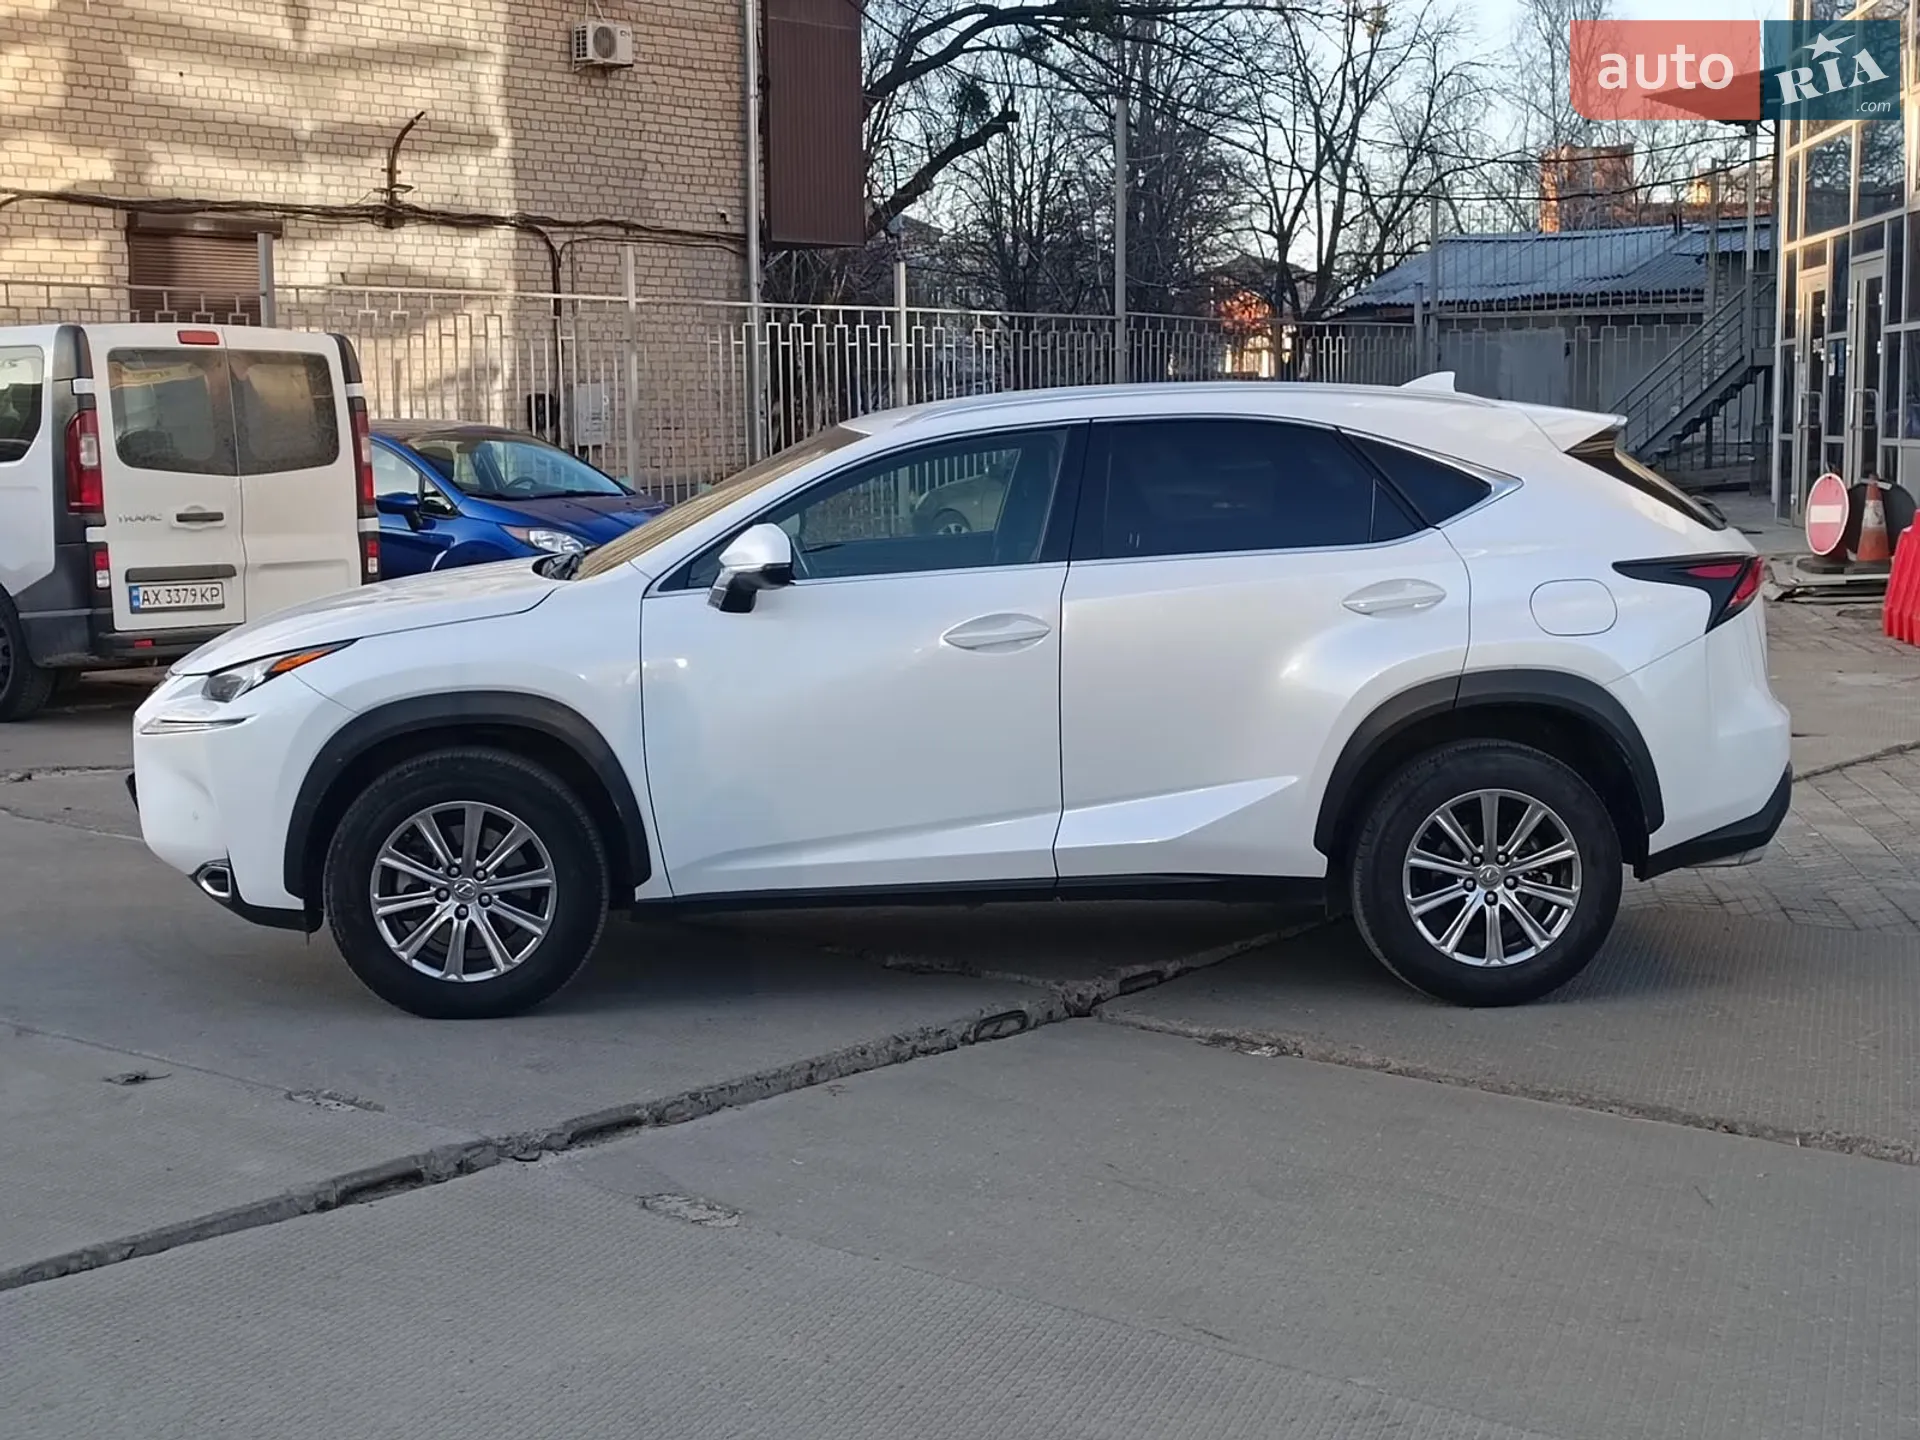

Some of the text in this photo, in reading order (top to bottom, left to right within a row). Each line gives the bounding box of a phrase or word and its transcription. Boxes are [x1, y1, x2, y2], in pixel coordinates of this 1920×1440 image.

[142, 586, 220, 605] AX 3379 KP
